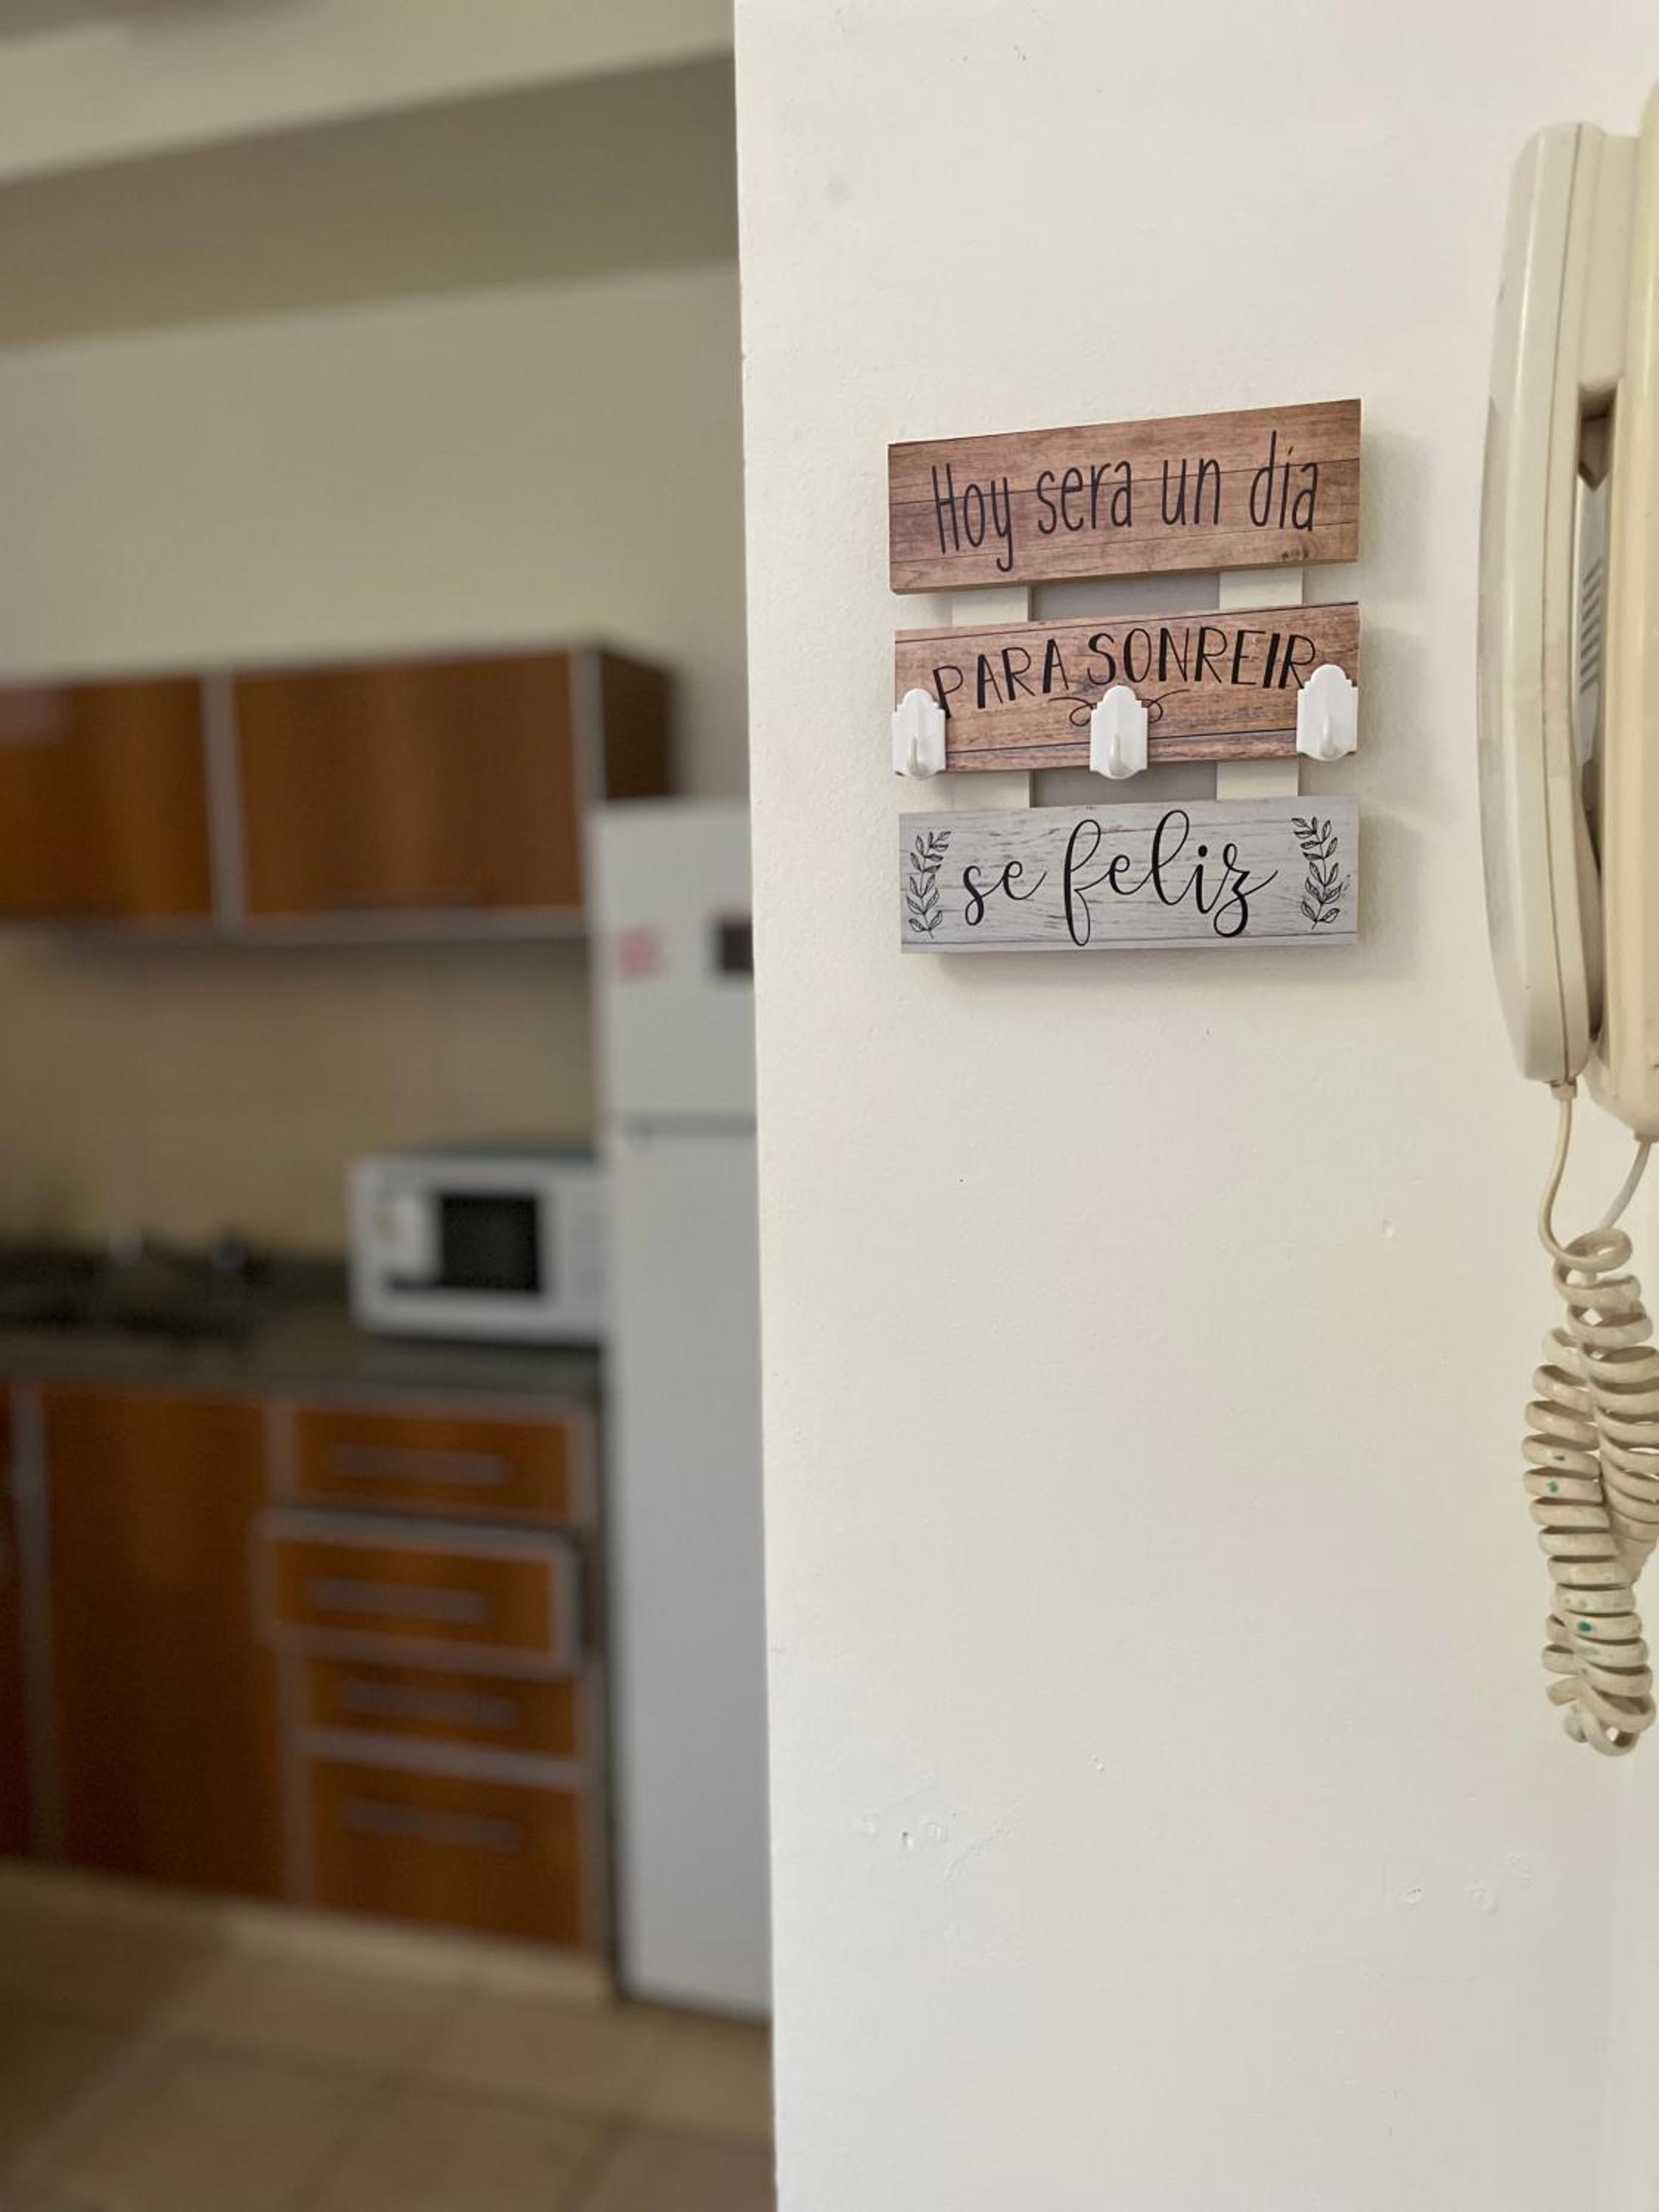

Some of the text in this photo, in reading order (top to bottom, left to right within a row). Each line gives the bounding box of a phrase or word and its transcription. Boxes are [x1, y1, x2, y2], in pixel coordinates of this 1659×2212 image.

[931, 462, 1014, 572] Hoy
[1035, 459, 1133, 535] sera
[1161, 456, 1219, 526] un
[932, 626, 1316, 720] PARA SONREIR
[962, 809, 1279, 947] se feliz
